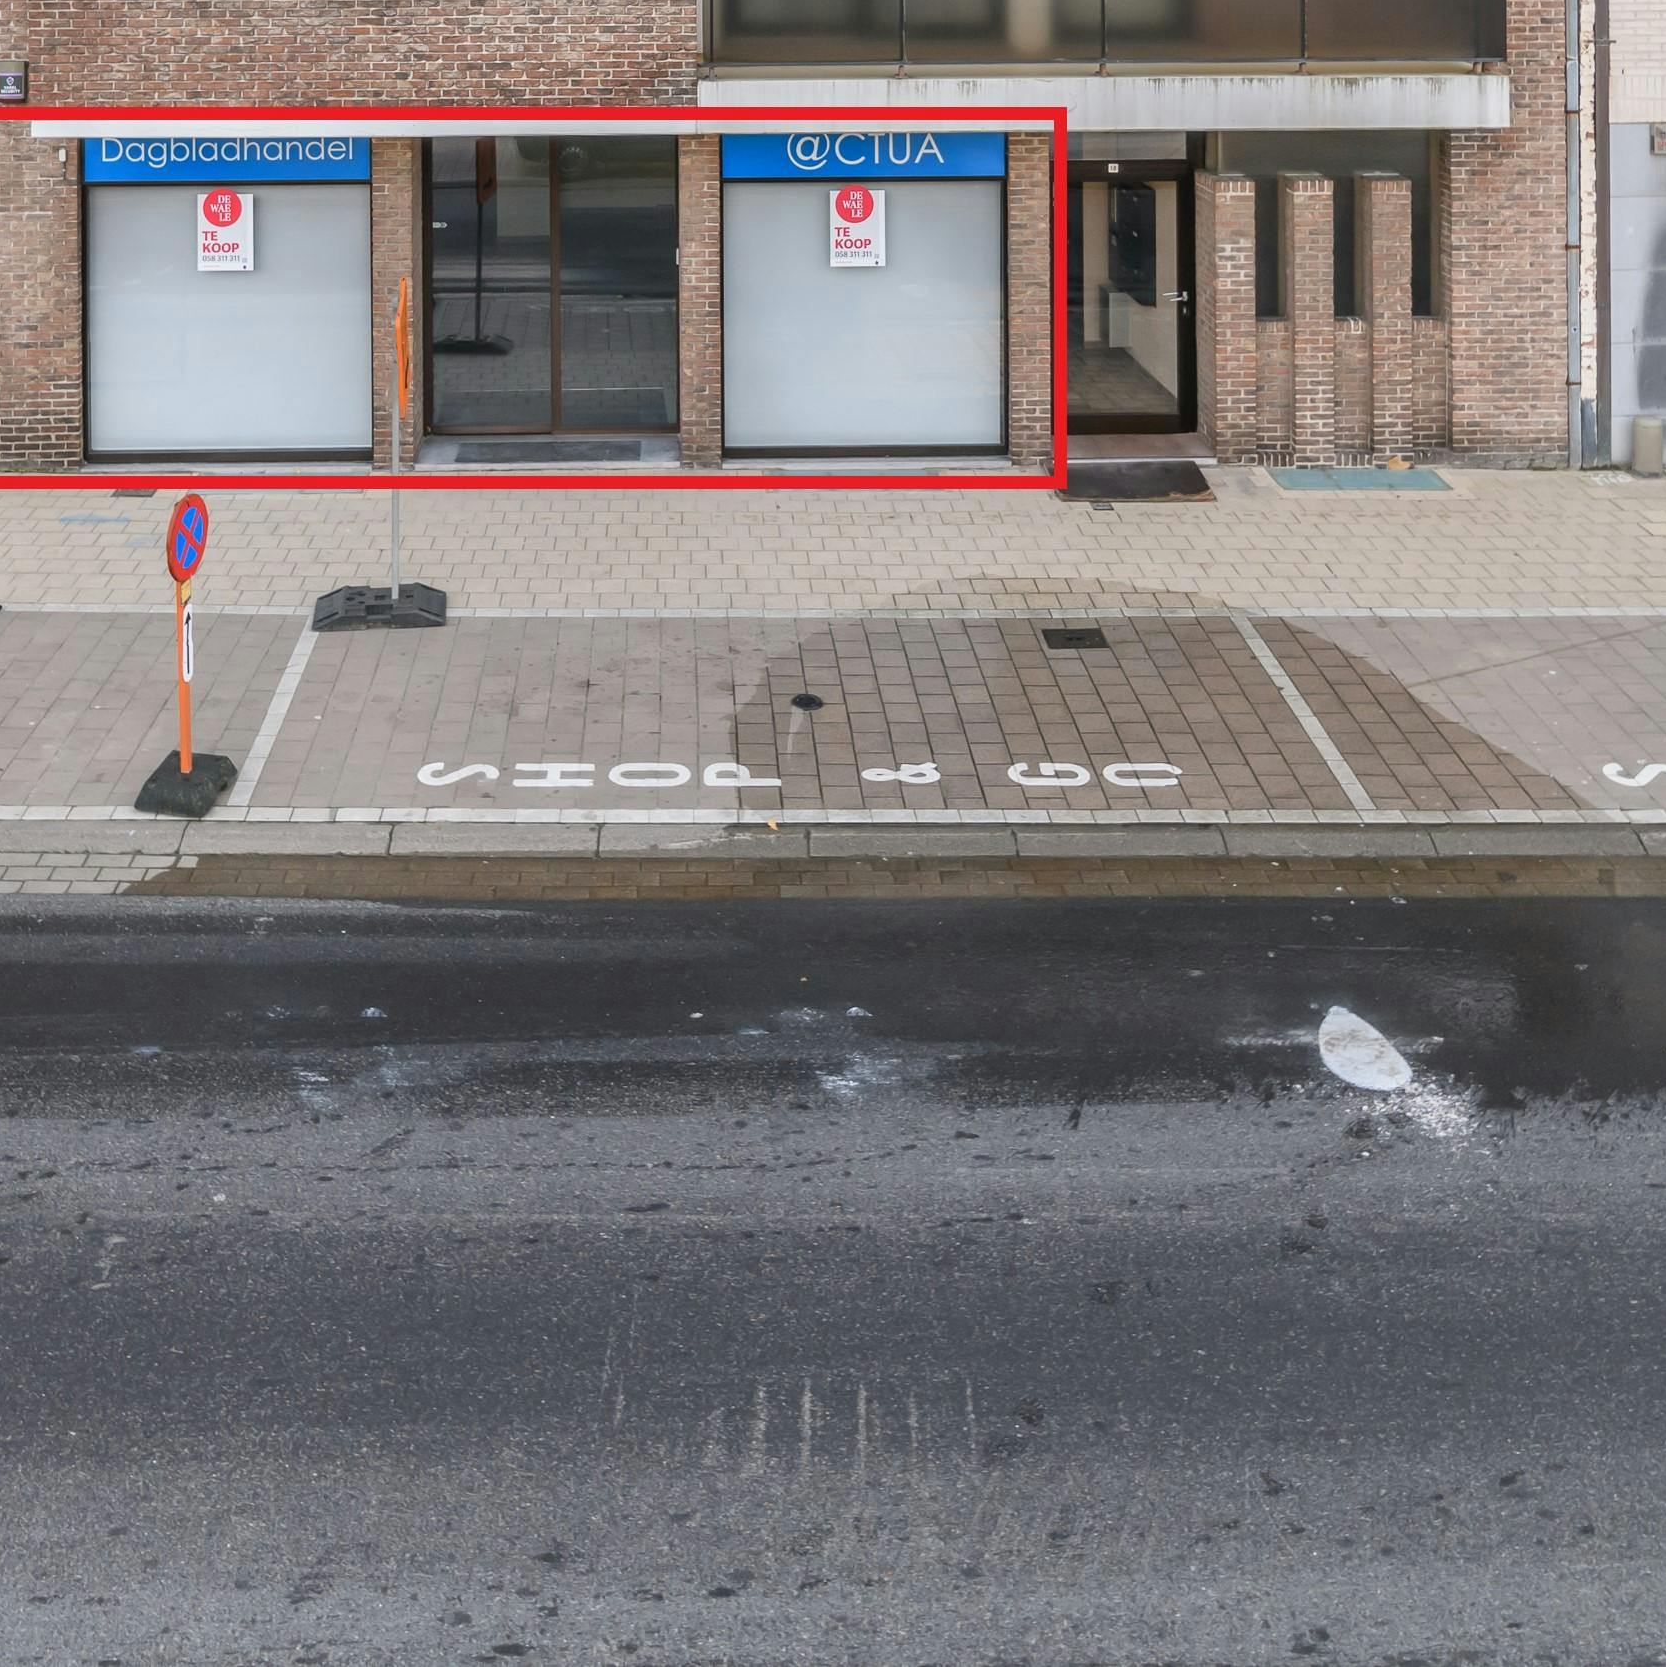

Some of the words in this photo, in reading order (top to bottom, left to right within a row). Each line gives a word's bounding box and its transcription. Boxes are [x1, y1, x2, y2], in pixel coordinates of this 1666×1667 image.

[102, 137, 353, 168] Dagbladhandel
[787, 133, 944, 170] @CTUA
[218, 195, 231, 203] DE
[850, 191, 863, 199] DE
[210, 204, 231, 213] WAE
[843, 200, 863, 209] WAE
[219, 213, 231, 221] LE
[851, 209, 863, 217] LE
[202, 231, 218, 241] TE
[834, 227, 850, 237] TE
[202, 243, 239, 253] KOOP
[835, 239, 872, 249] KOOP
[417, 762, 782, 787] SHOP
[861, 762, 941, 784] &
